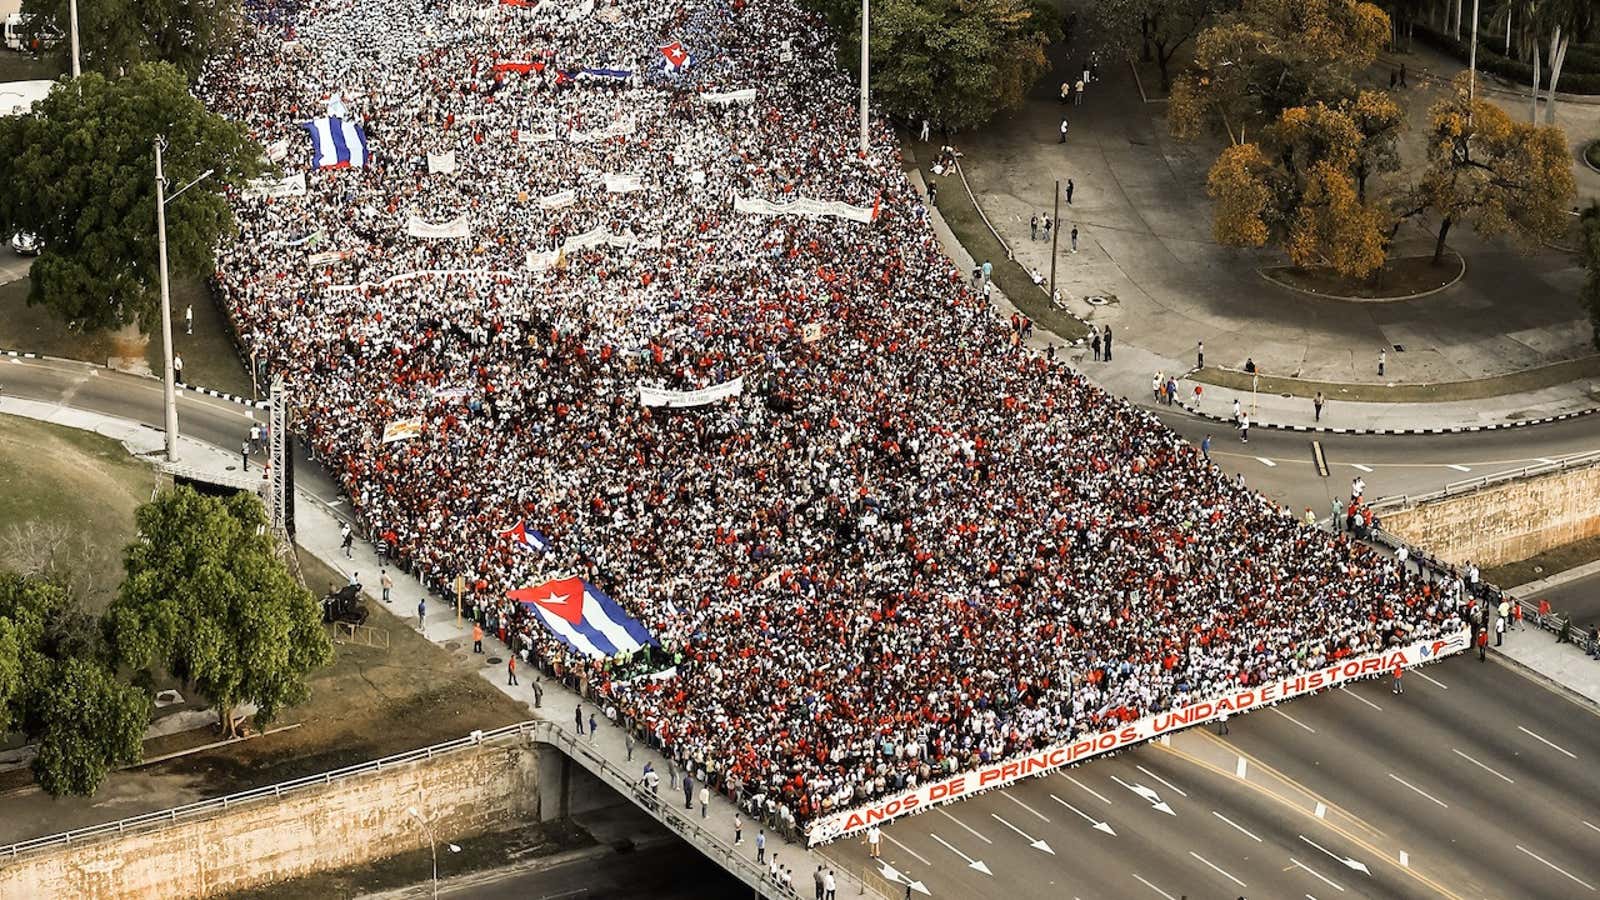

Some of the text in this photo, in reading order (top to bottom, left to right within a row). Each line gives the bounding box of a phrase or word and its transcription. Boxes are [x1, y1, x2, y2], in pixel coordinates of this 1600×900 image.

[930, 778, 963, 801] DE
[979, 726, 1143, 785] PRINCIPIOS.
[1153, 691, 1255, 732] UNIDAD
[1261, 682, 1277, 702] E
[1283, 652, 1409, 694] HISTORIA
